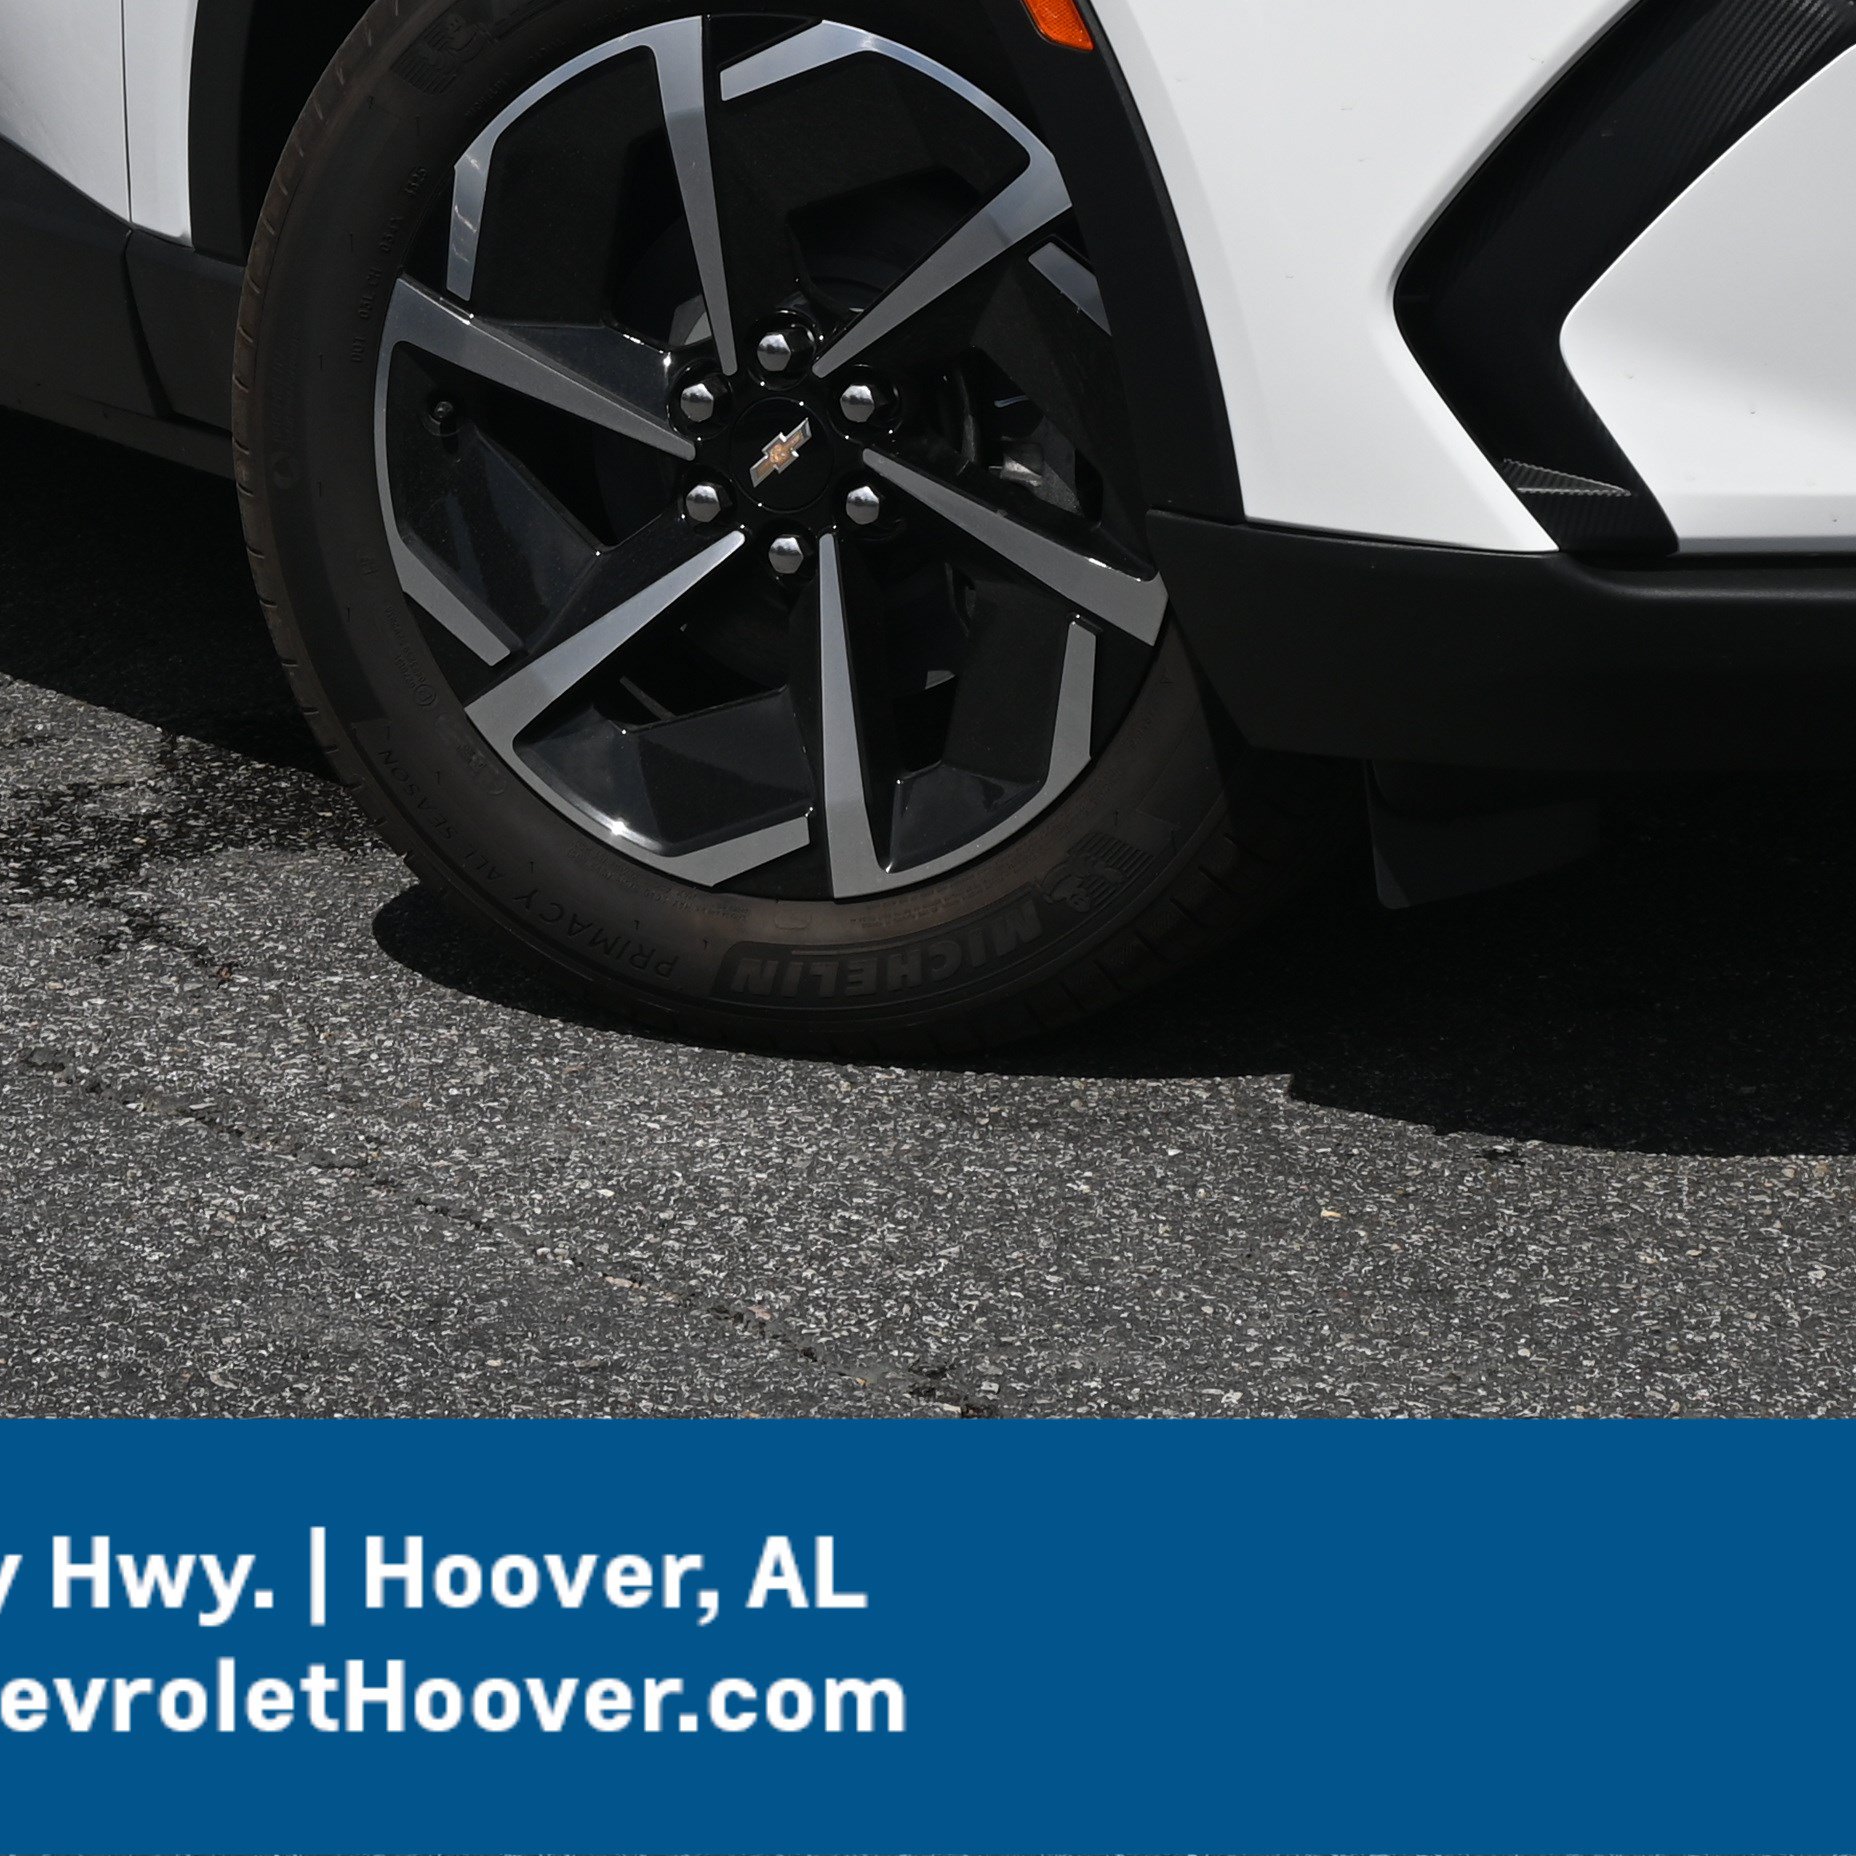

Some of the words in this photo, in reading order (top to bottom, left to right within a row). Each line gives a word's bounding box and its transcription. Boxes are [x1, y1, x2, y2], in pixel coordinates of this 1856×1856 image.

[377, 749, 454, 841] SEASON
[461, 848, 504, 882] ALL
[513, 888, 681, 981] PRIMACY
[731, 899, 1043, 999] MICHELIN
